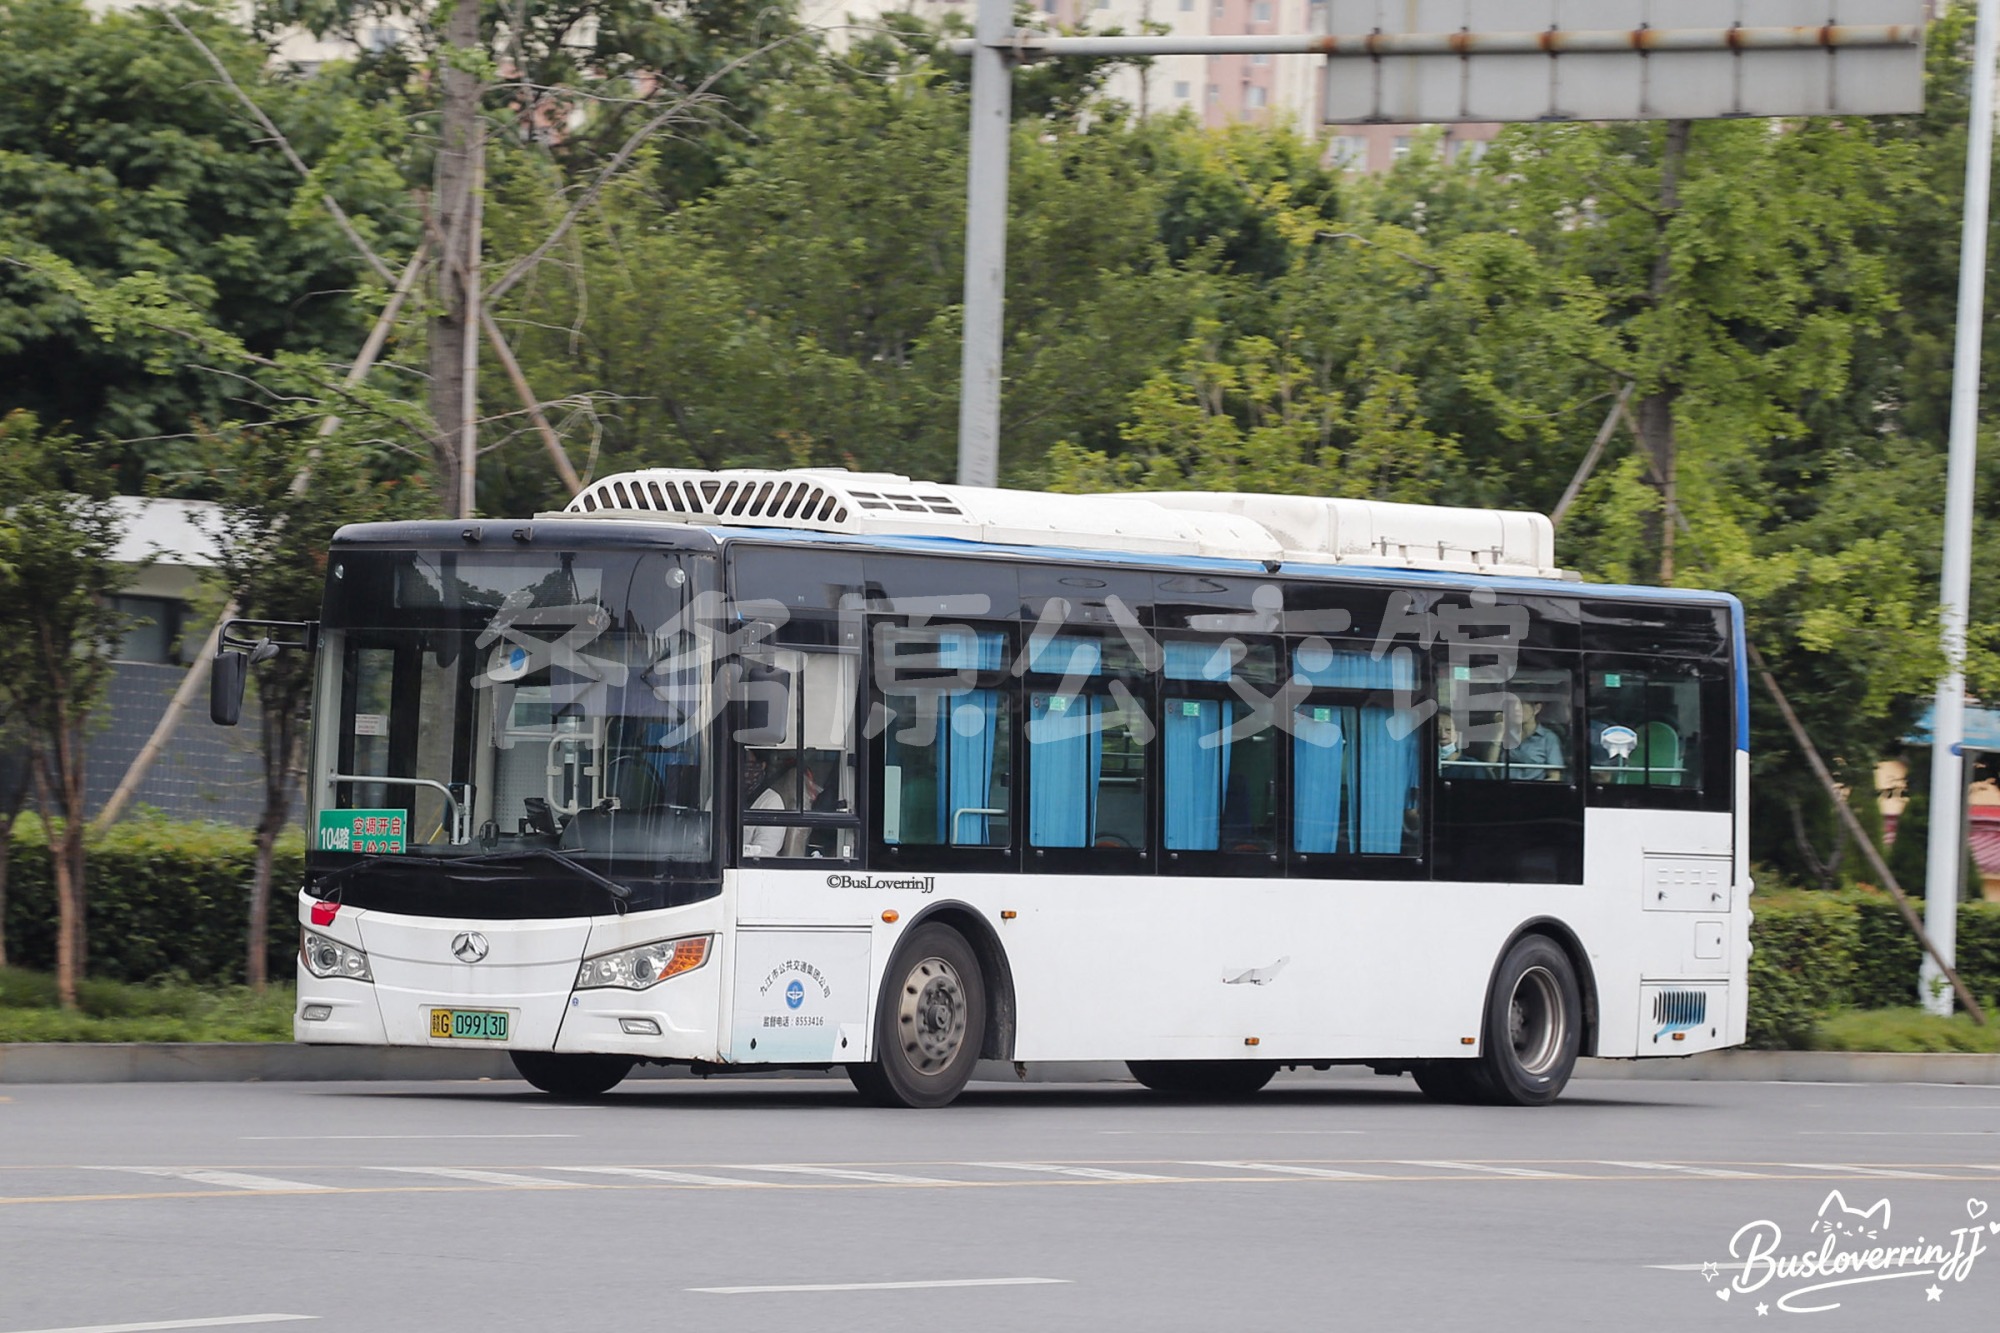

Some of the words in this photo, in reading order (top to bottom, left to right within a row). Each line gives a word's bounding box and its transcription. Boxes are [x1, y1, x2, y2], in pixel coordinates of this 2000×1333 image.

[353, 817, 402, 835] 空调开启
[320, 827, 350, 850] 104路
[760, 959, 831, 998] 九江市公共交通集团公司
